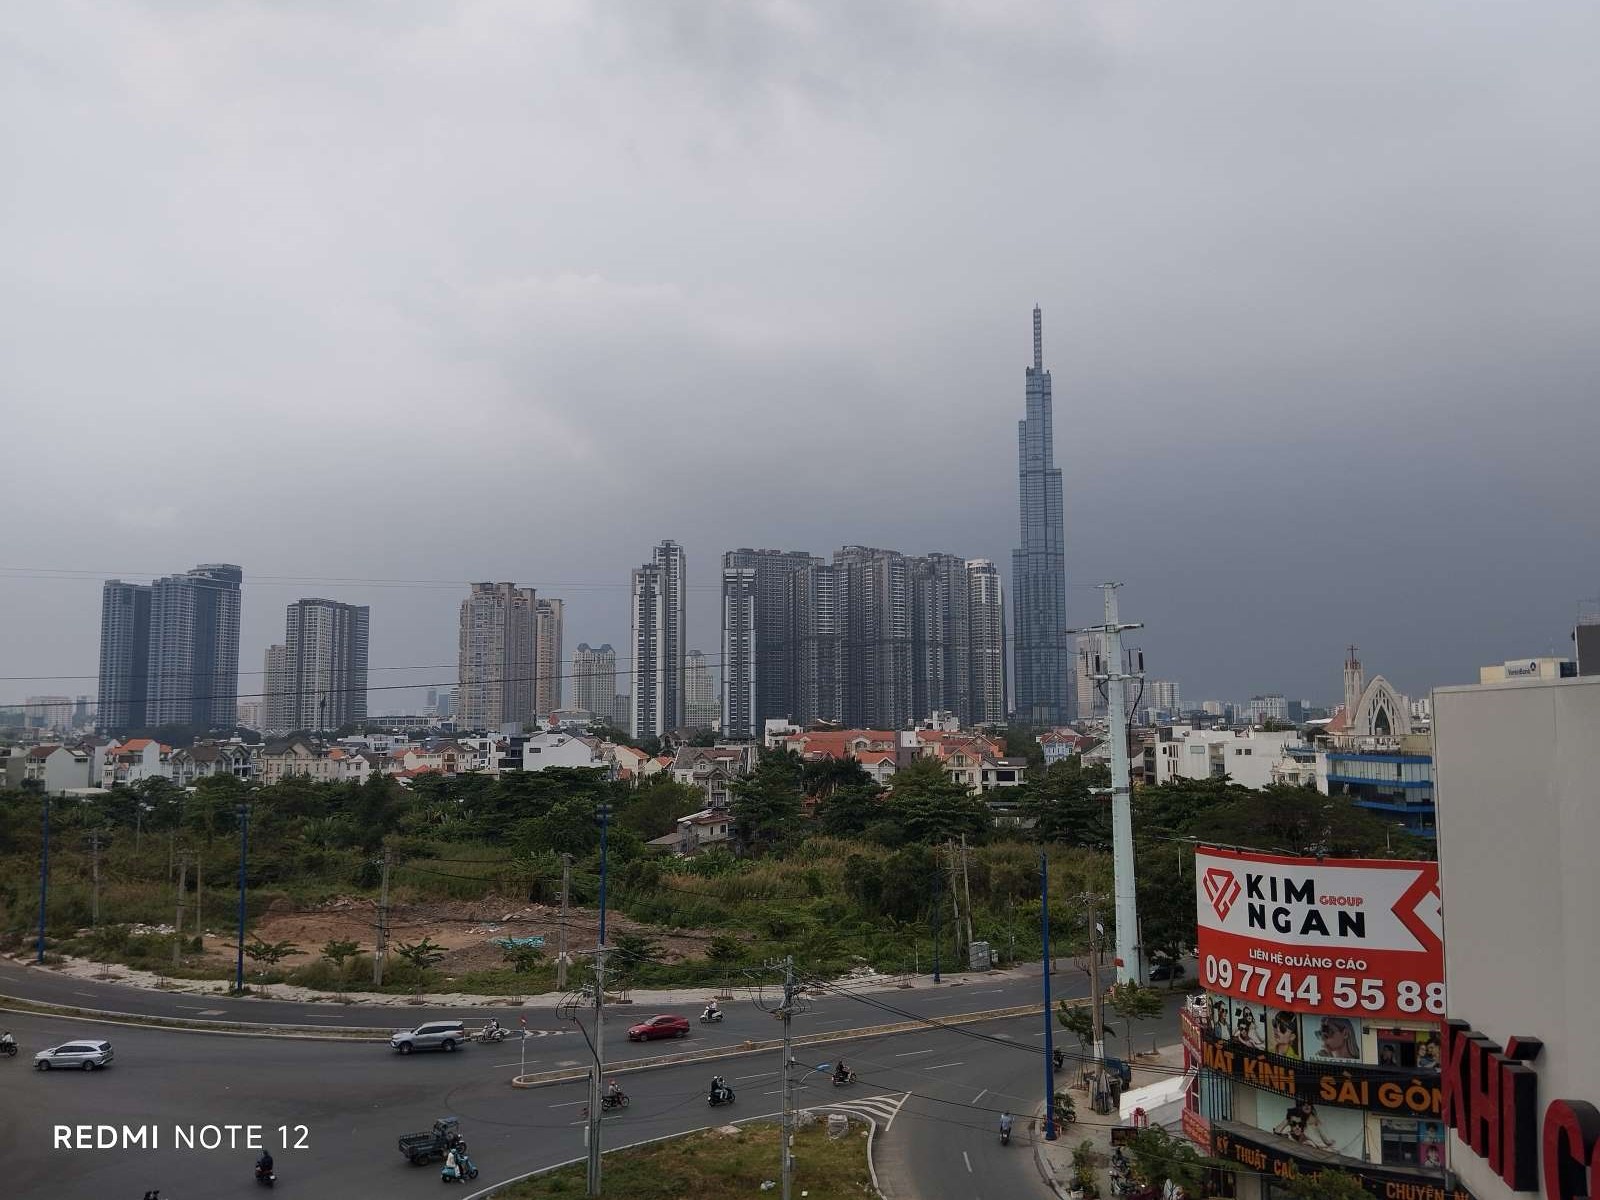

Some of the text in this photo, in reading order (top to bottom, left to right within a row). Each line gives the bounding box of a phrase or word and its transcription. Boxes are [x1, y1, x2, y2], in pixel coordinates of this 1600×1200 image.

[1246, 873, 1315, 905] KIM
[1319, 895, 1363, 907] GROUP
[1248, 902, 1366, 938] NGAN
[1249, 947, 1368, 971] LIÊN HỆ QUẢNG CÁO
[1333, 977, 1385, 1011] 55
[1397, 980, 1446, 1015] 88
[1244, 1054, 1296, 1096] KÍNH
[1320, 1071, 1369, 1105] SÀI
